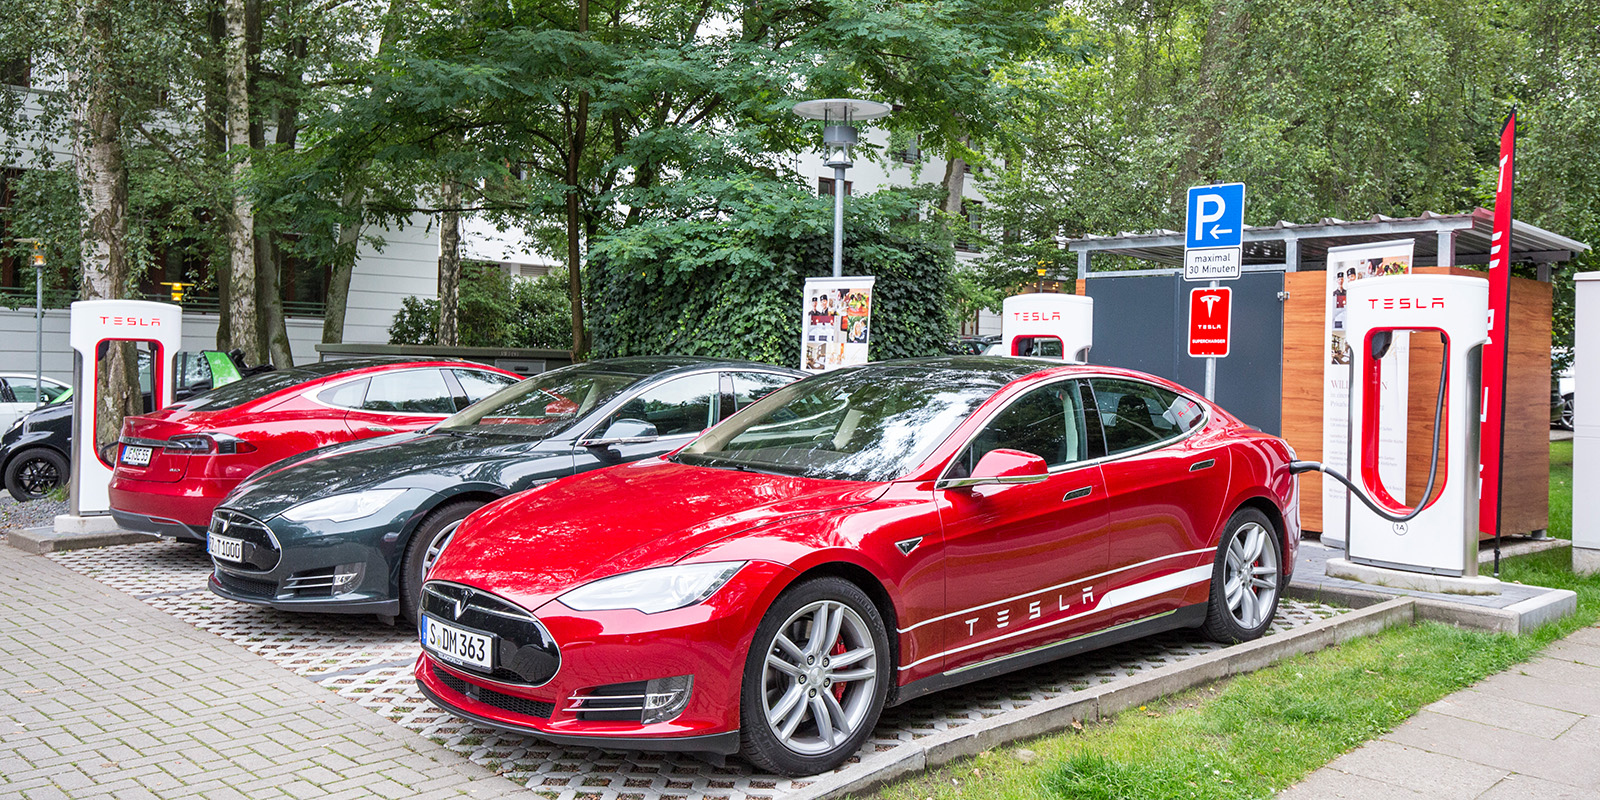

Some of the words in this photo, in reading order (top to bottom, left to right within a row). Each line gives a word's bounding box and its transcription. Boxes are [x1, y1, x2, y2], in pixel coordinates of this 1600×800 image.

[1195, 193, 1226, 241] P
[1194, 253, 1231, 263] maximal
[1189, 265, 1199, 275] 30
[1201, 264, 1236, 274] Minuten
[1367, 297, 1445, 310] TESLA
[99, 316, 161, 327] TESLA
[1013, 311, 1061, 322] TESLA
[1395, 523, 1406, 532] 1A
[965, 585, 1094, 637] TESLA
